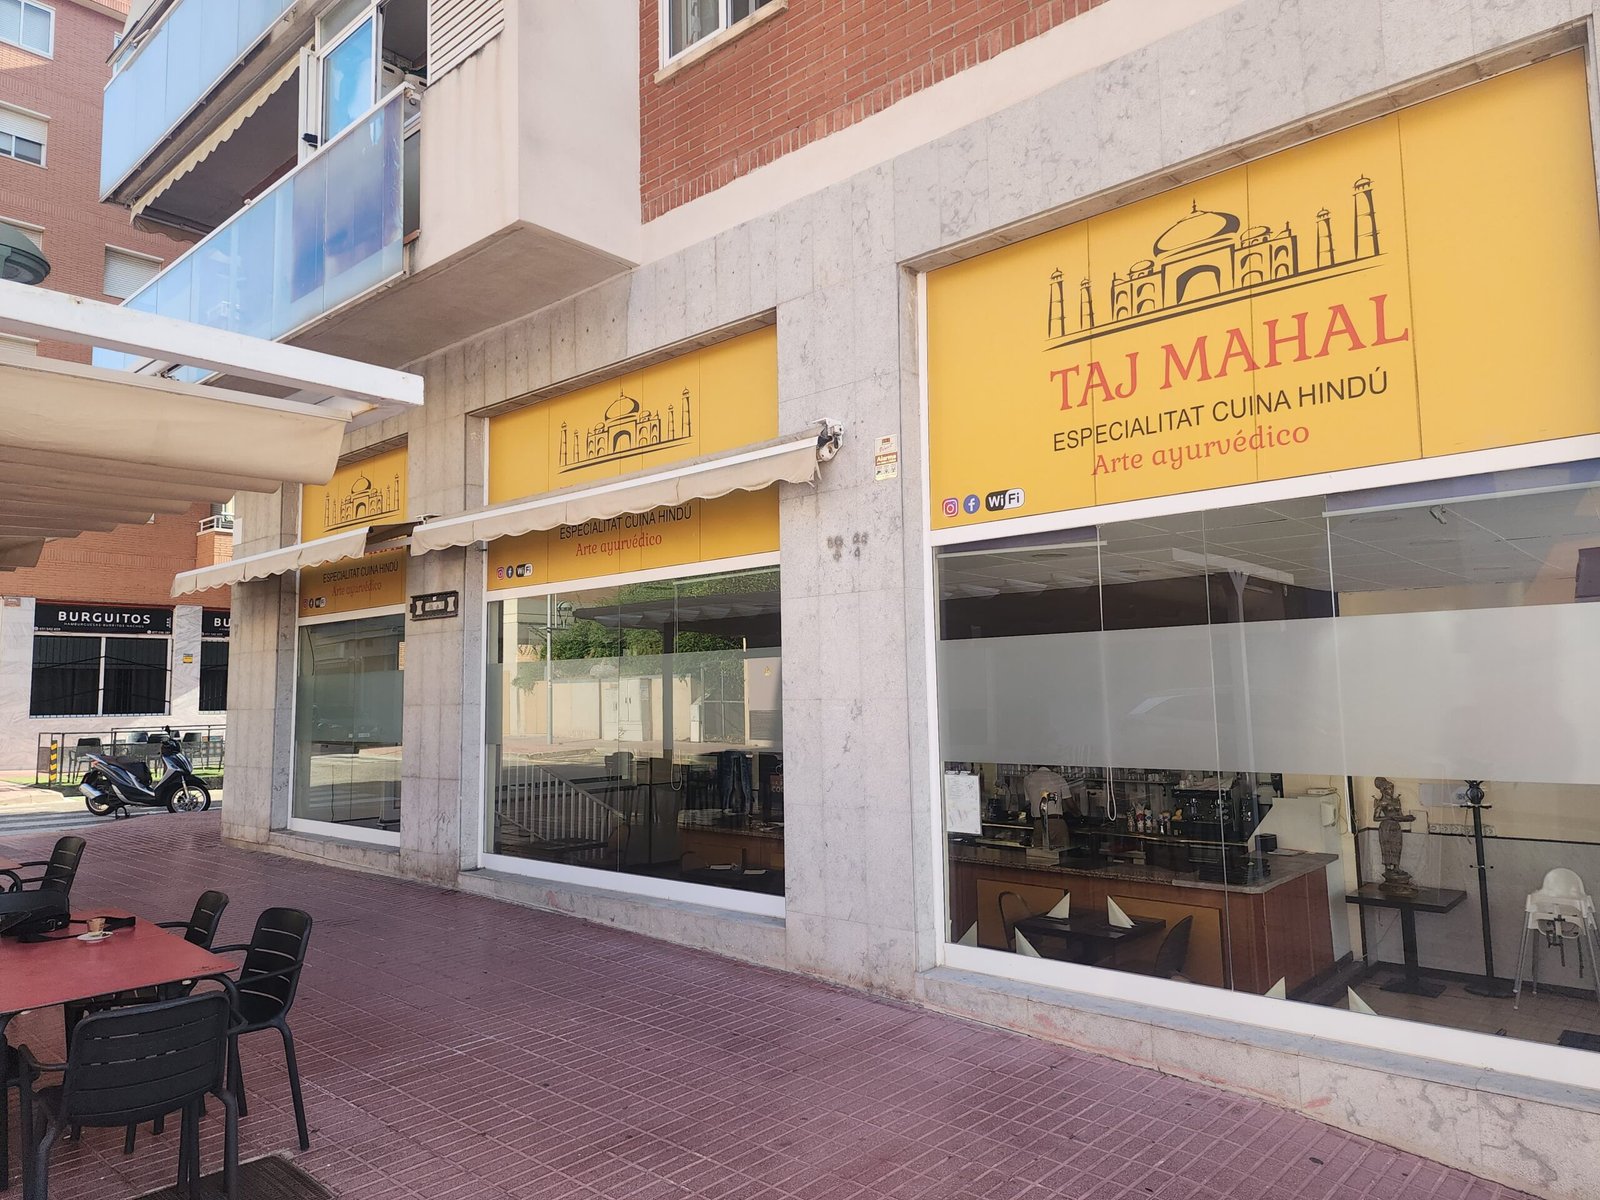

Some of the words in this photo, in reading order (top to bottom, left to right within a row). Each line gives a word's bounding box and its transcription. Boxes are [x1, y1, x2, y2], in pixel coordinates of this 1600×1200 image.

[1050, 351, 1139, 411] TAJ
[1159, 293, 1409, 390] MAHAL
[1053, 405, 1205, 452] ESPECIALITAT
[1212, 390, 1292, 422] CUINA
[1298, 366, 1388, 407] HINDÚ
[1091, 454, 1143, 476] Arte
[1152, 422, 1310, 470] ayurvédico
[559, 517, 623, 540] ESPECIALITAT
[625, 511, 655, 529] CUINA
[658, 503, 692, 524] HINDÚ
[575, 543, 597, 557] Arte
[600, 532, 662, 556] ayurvédico
[322, 567, 360, 583] ESPECIALITAT
[58, 611, 151, 624] BURGUITOS
